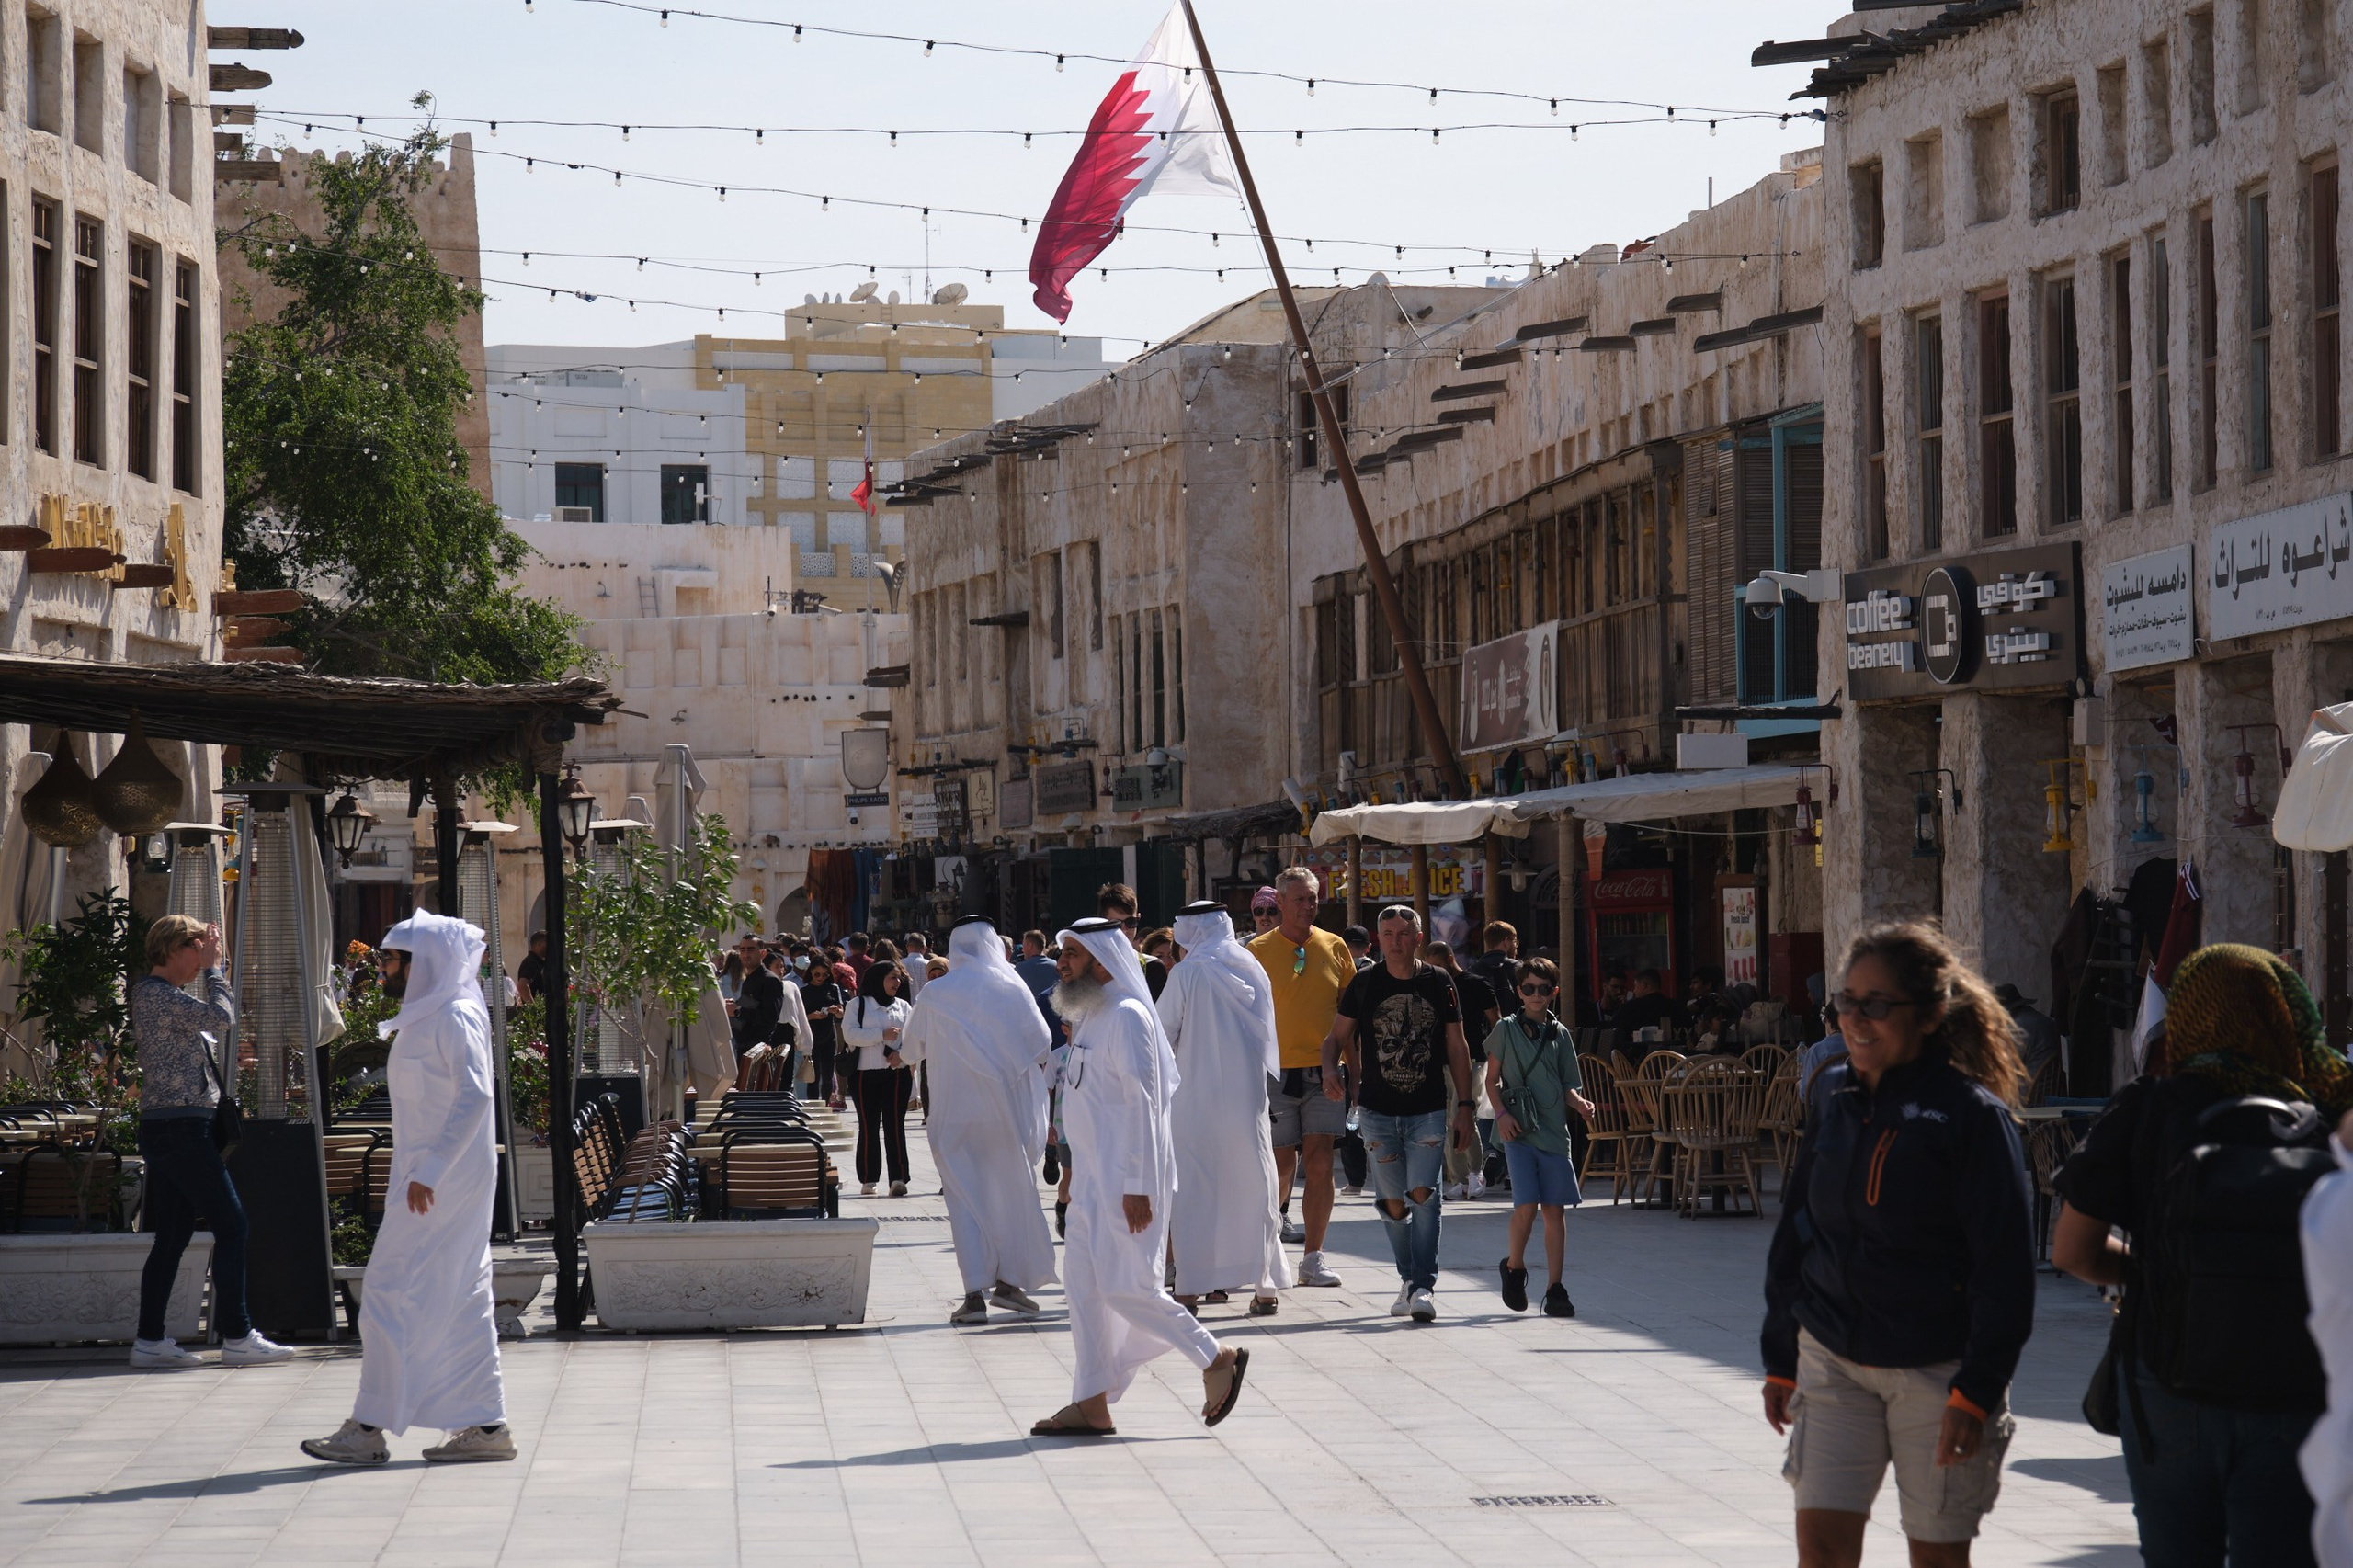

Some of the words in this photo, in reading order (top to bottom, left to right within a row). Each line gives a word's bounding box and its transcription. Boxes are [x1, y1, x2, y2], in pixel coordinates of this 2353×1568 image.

[2215, 529, 2270, 601] للتراث
[1846, 589, 1911, 634] coffee
[1847, 641, 1912, 673] beanery
[1402, 867, 1465, 897] JICE
